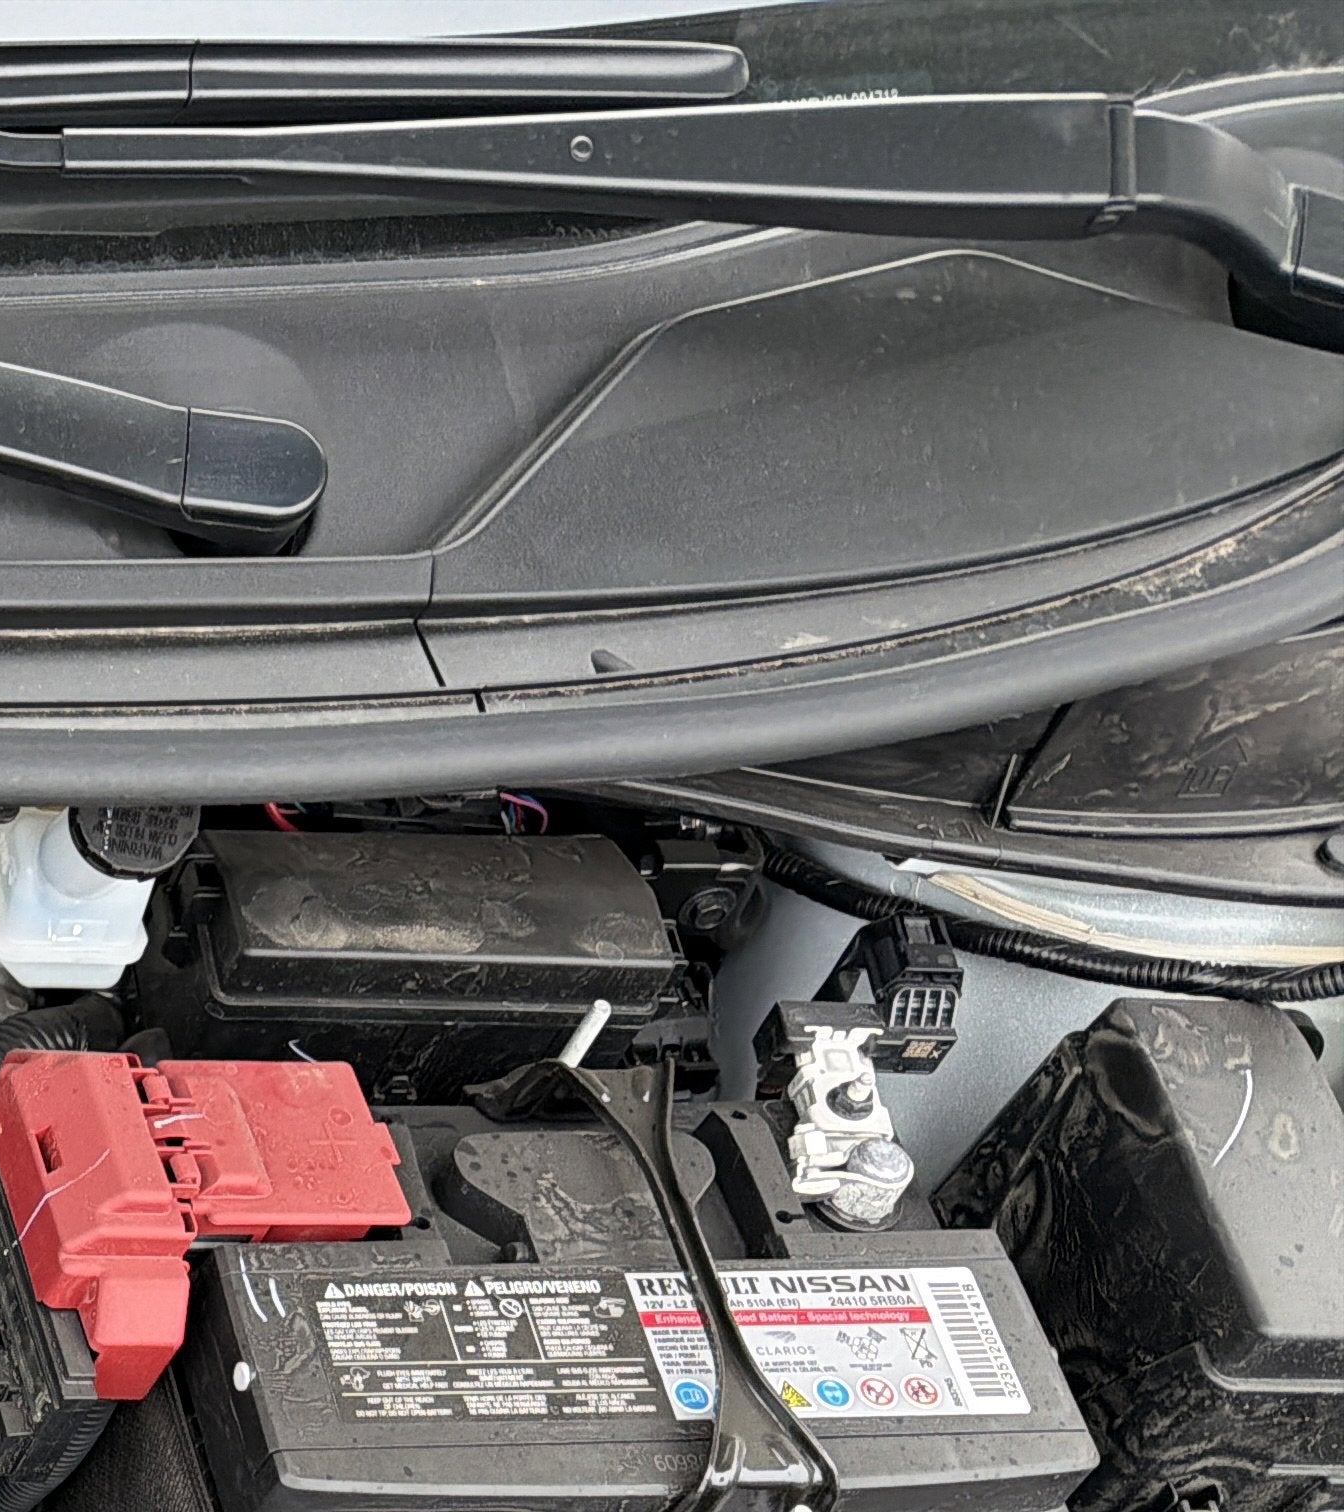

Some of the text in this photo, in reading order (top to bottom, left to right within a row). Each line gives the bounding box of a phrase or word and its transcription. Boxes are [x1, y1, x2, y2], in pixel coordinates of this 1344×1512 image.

[343, 1282, 458, 1297] DANGER/POISON
[484, 1279, 602, 1295] PELIGRO/VENENO
[634, 1274, 911, 1296] RENULT NISSAN
[828, 1296, 868, 1307] 24410
[808, 1311, 847, 1324] Special
[849, 1310, 911, 1324] technology
[755, 1346, 816, 1356] CLARIOS
